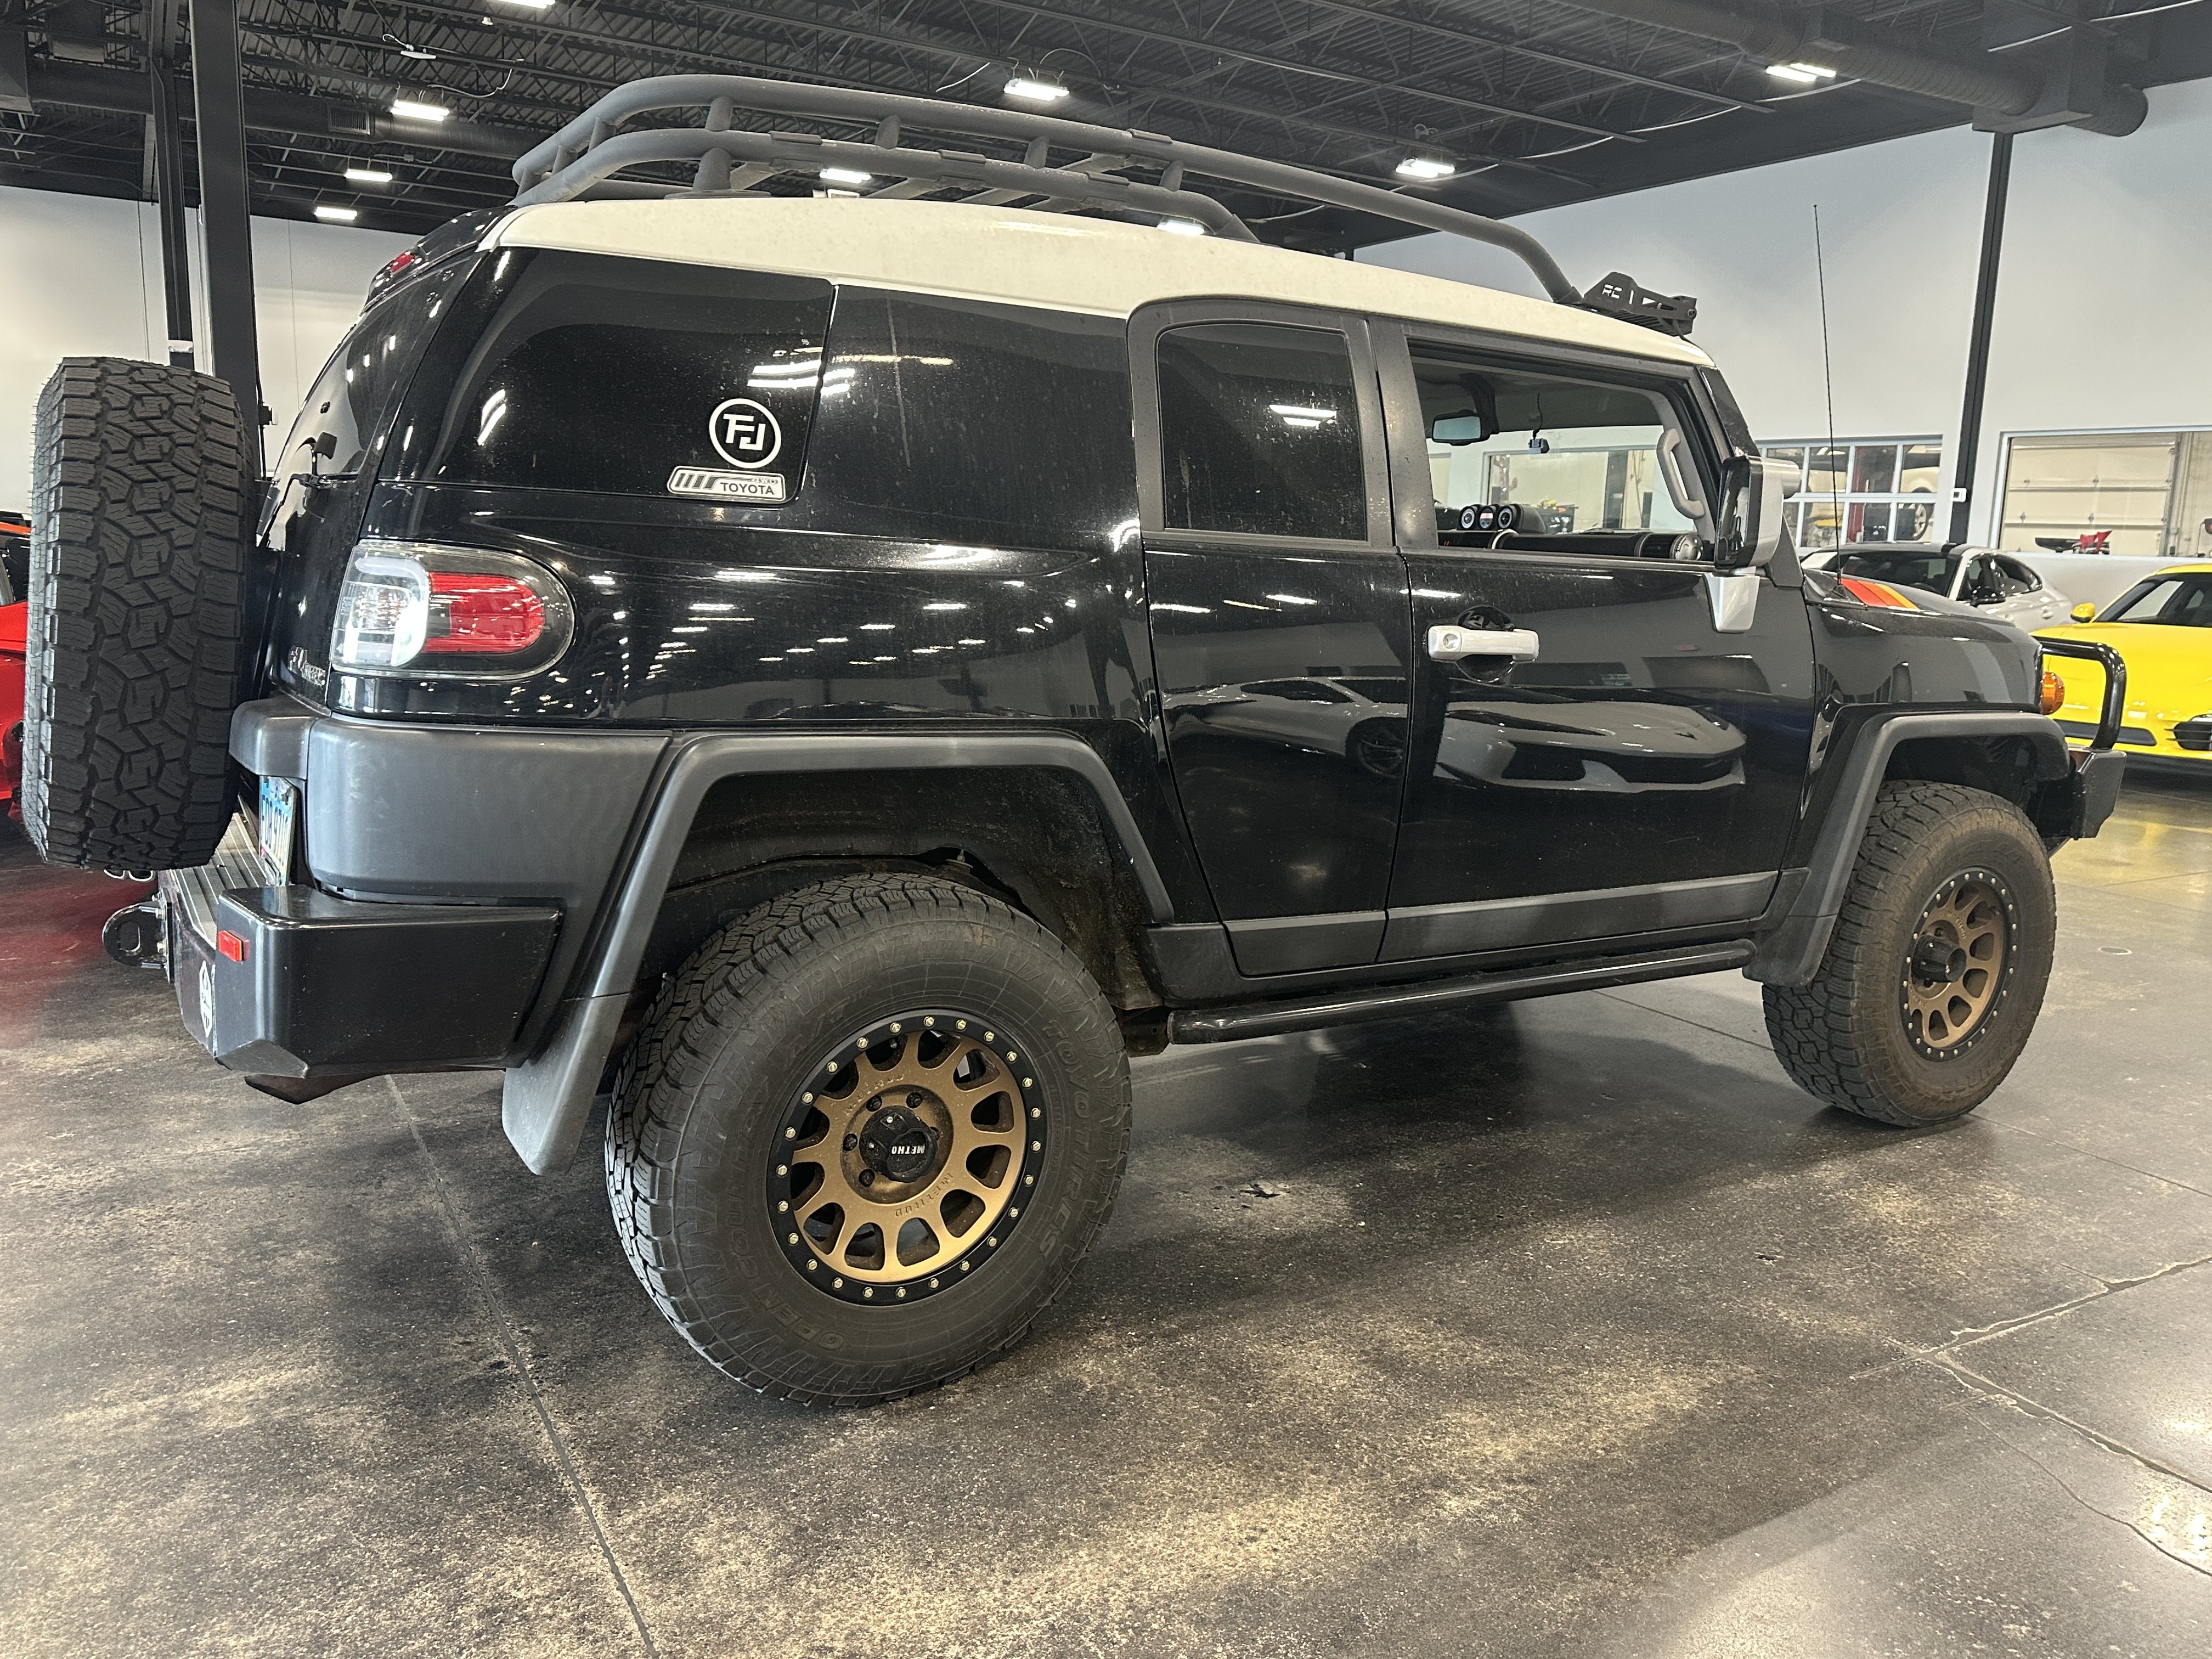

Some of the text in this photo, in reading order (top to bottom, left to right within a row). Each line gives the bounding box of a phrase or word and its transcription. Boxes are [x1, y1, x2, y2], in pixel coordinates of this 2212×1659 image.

[723, 414, 766, 450] FJ
[720, 483, 775, 495] TOYOTA
[1040, 1019, 1091, 1261] TOYO TIRES
[753, 1282, 846, 1351] OPEN
